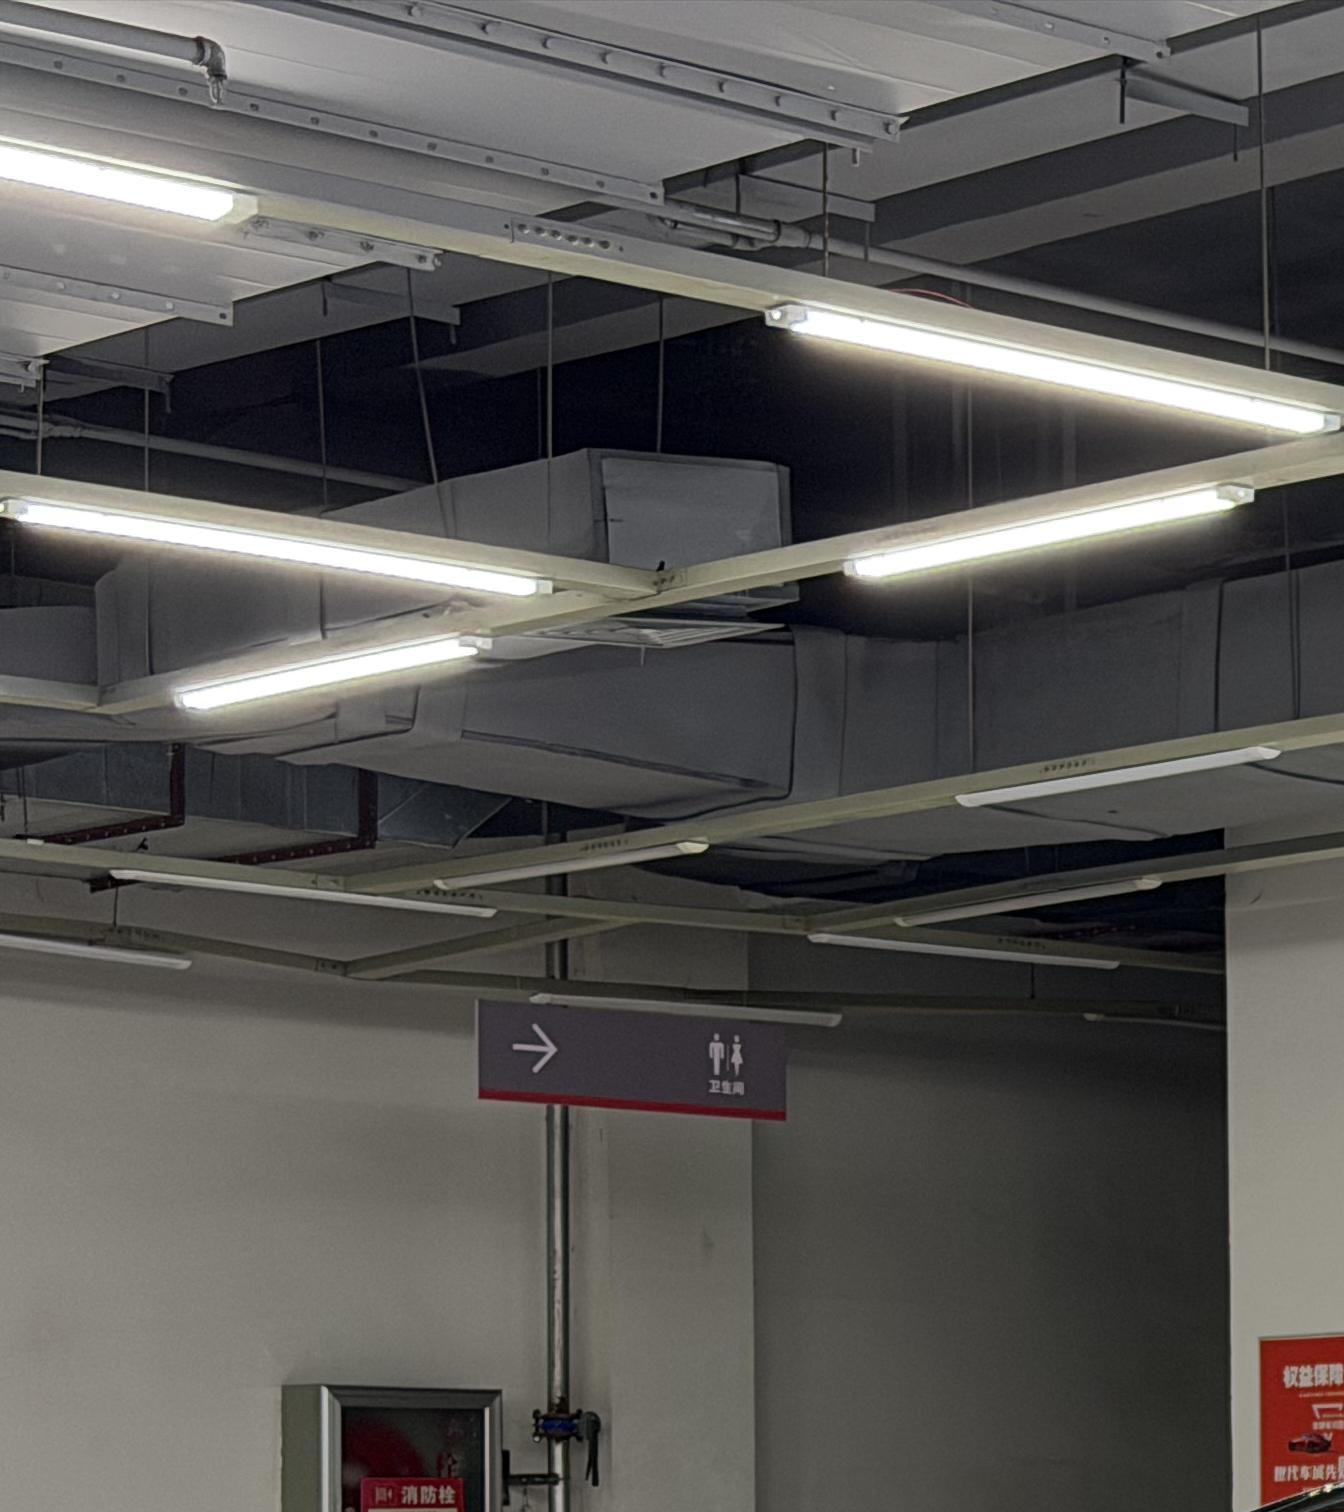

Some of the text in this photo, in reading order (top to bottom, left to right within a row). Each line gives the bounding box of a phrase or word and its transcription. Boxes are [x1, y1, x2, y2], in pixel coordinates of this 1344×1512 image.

[708, 1079, 745, 1096] 卫生间
[401, 1486, 456, 1505] 消防栓
